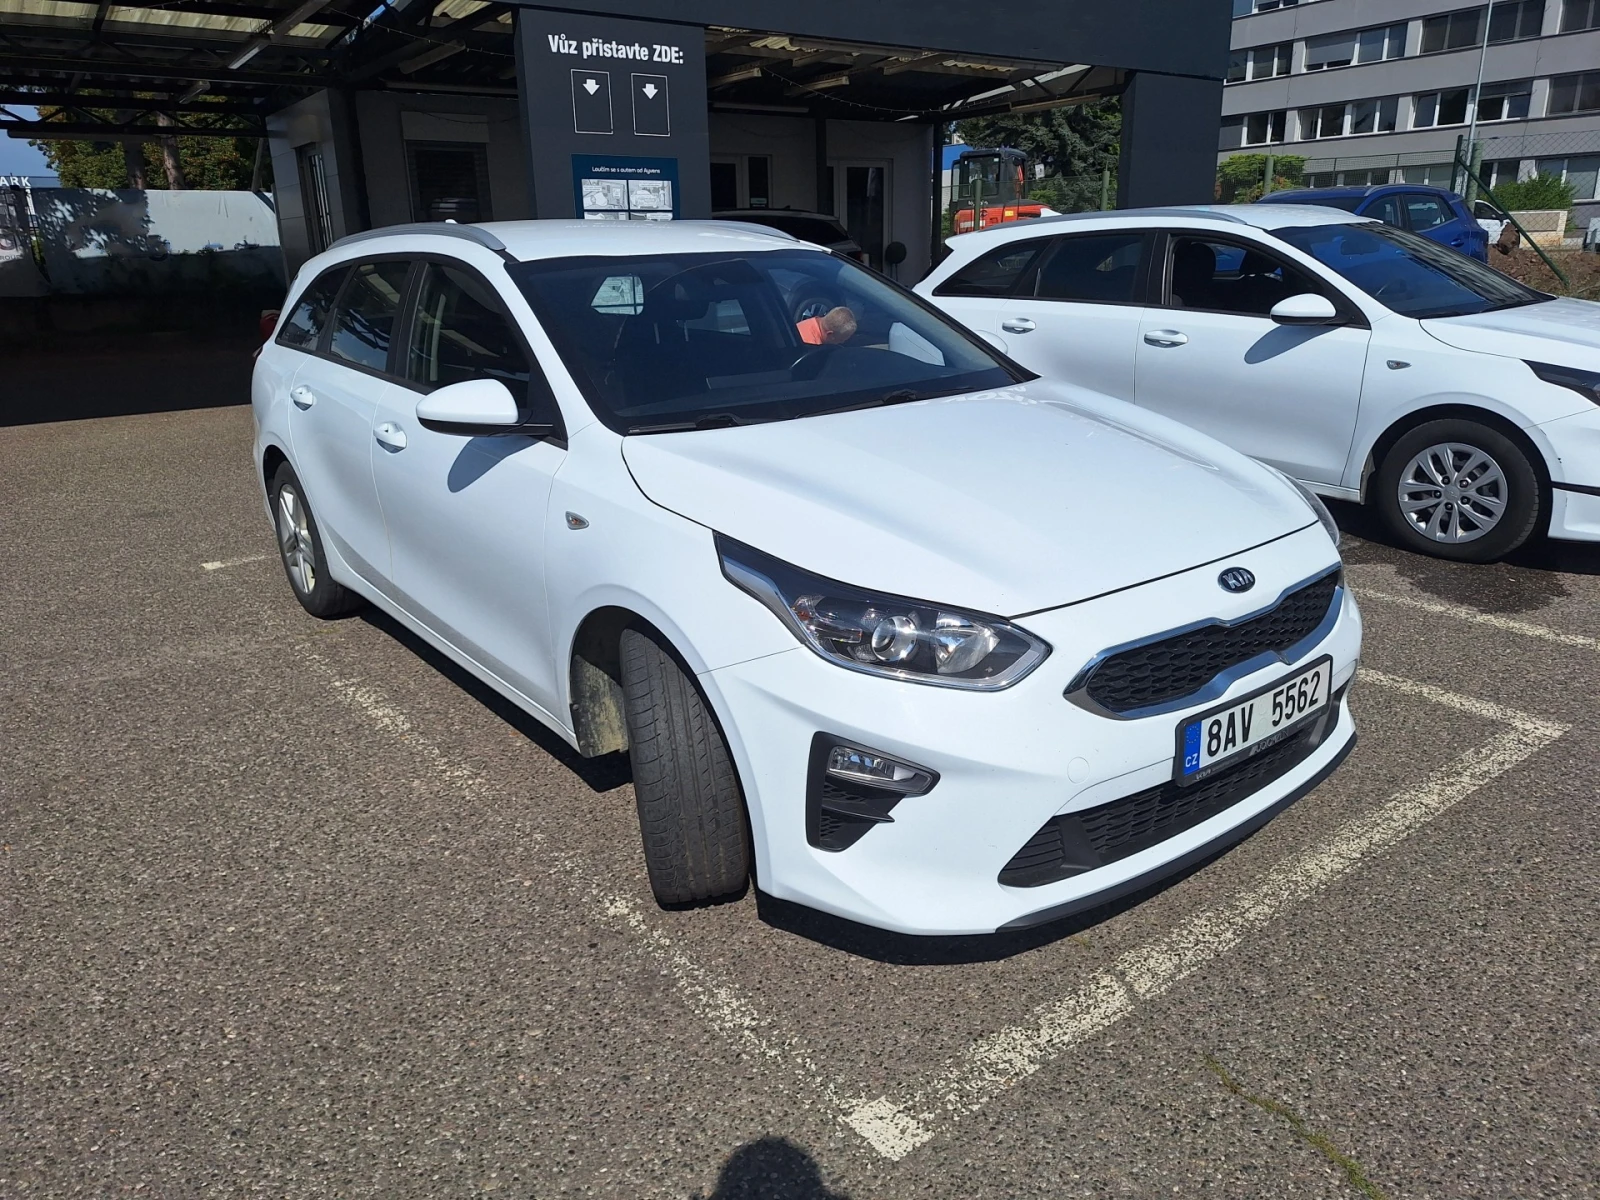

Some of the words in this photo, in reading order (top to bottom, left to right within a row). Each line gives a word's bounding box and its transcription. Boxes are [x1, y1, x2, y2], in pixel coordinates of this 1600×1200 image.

[547, 33, 578, 55] Vůz
[582, 37, 649, 61] přistavte
[652, 44, 684, 64] ZDE:
[1222, 569, 1253, 589] KIA
[1206, 702, 1254, 757] 8AV
[1271, 670, 1321, 727] 5562
[1184, 752, 1198, 768] CZ
